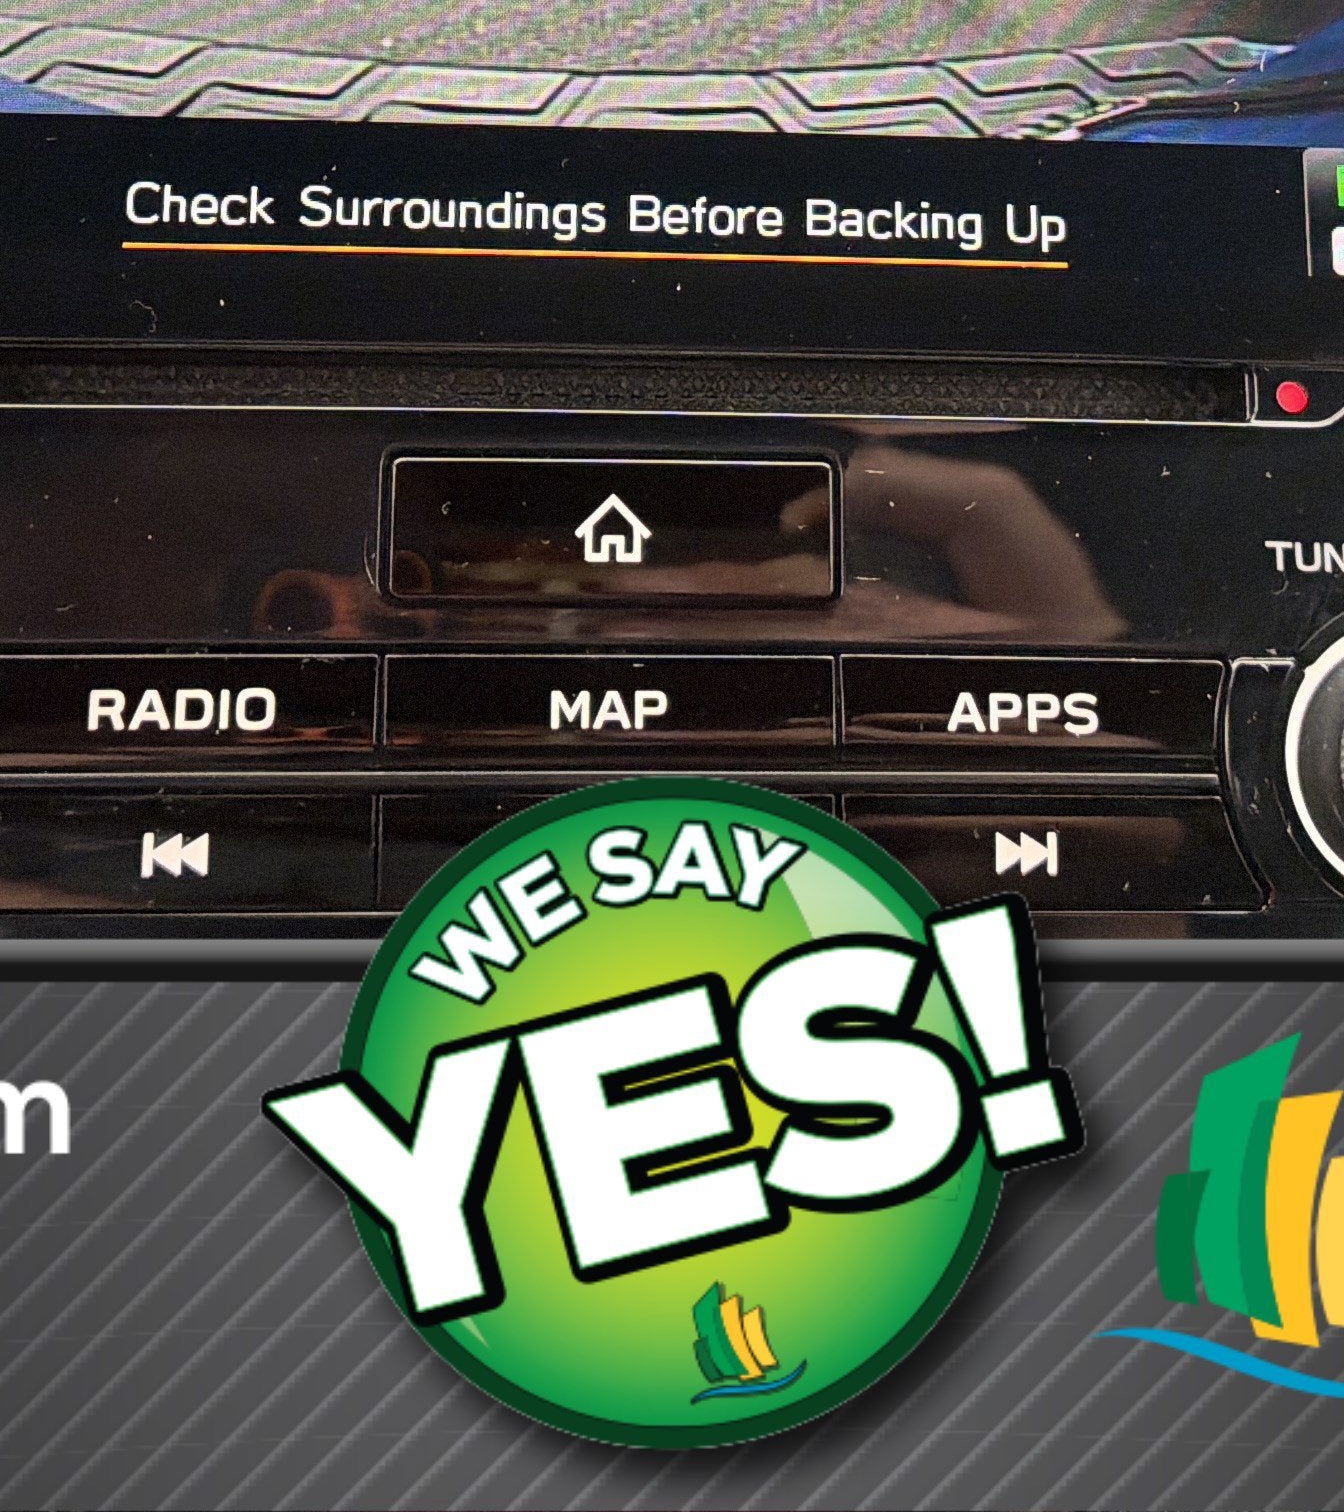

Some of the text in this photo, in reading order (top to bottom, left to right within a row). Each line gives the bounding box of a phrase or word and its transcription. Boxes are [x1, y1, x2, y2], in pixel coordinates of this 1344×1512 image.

[125, 181, 1067, 254] Check Surroundings Before Backing Up
[87, 687, 277, 732] RADIO
[549, 689, 669, 730] MAP
[946, 691, 1100, 736] APPS
